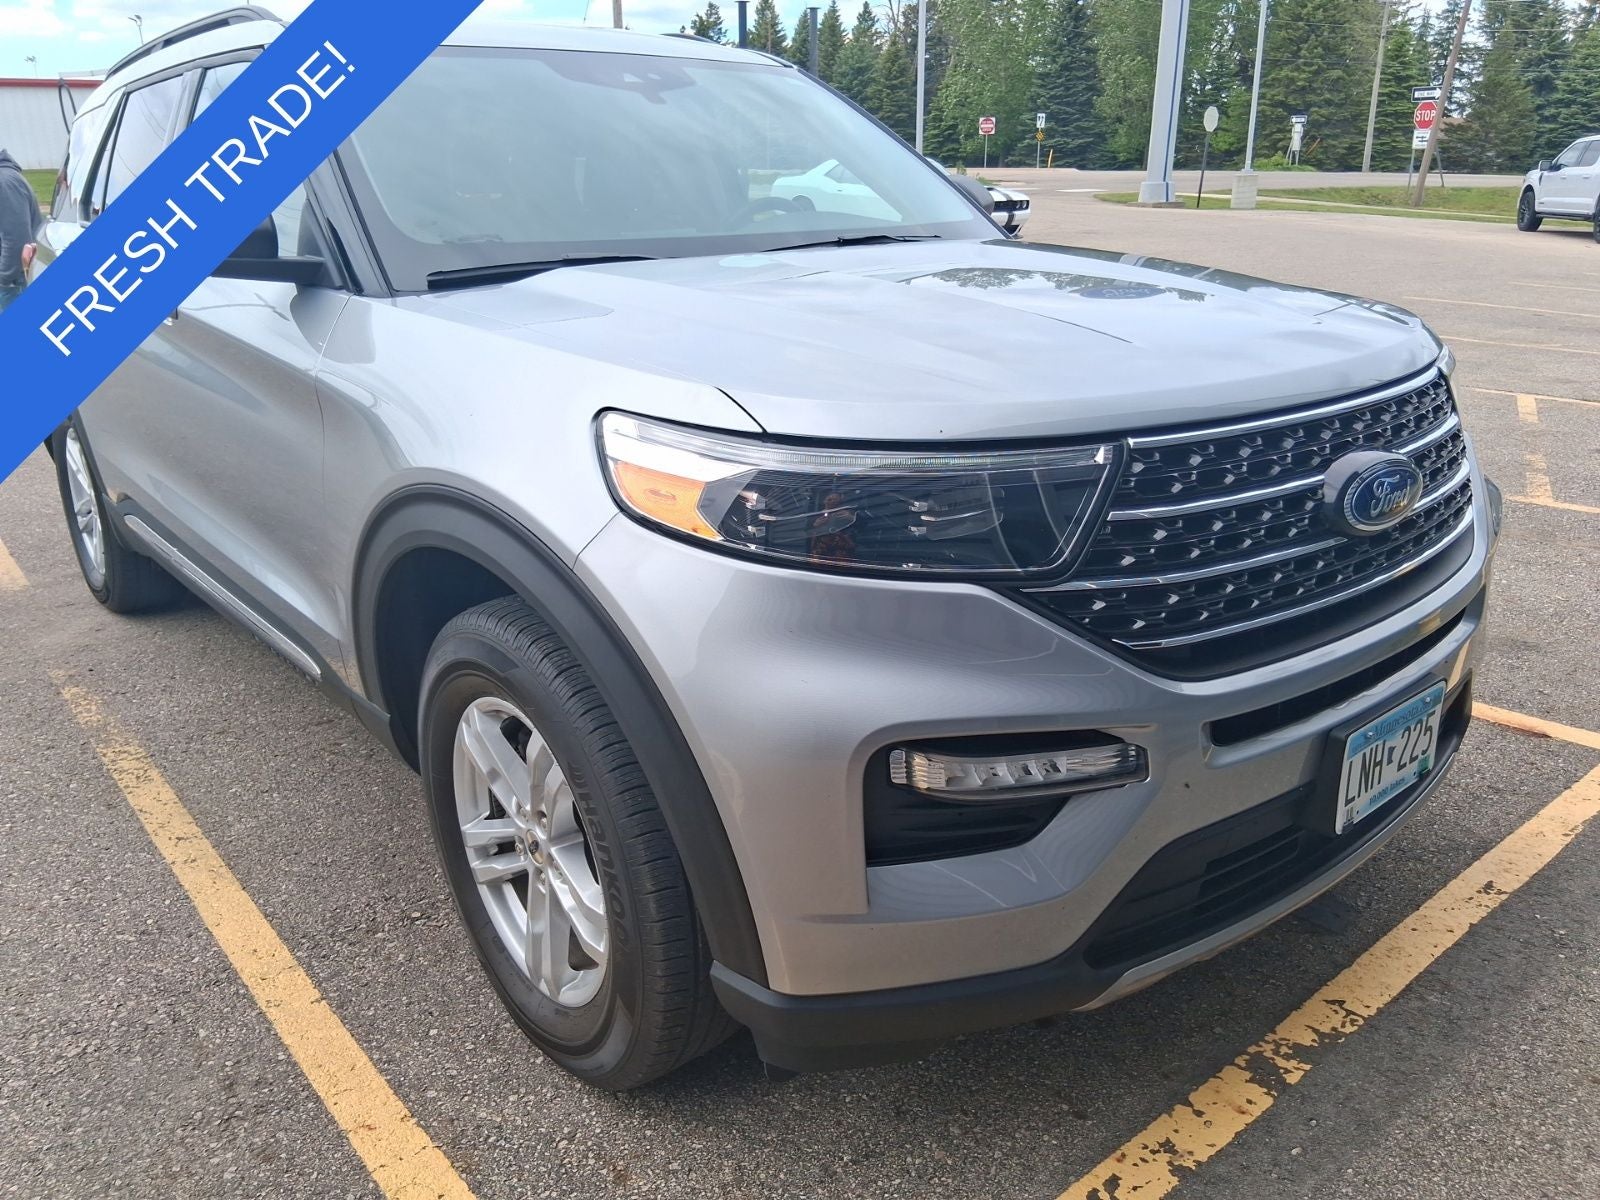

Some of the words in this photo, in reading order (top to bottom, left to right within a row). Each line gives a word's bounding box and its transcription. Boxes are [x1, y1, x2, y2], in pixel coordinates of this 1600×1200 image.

[1416, 110, 1436, 121] STOP
[1370, 475, 1411, 517] Ford
[1345, 740, 1386, 804] LNH
[1397, 710, 1436, 772] 225
